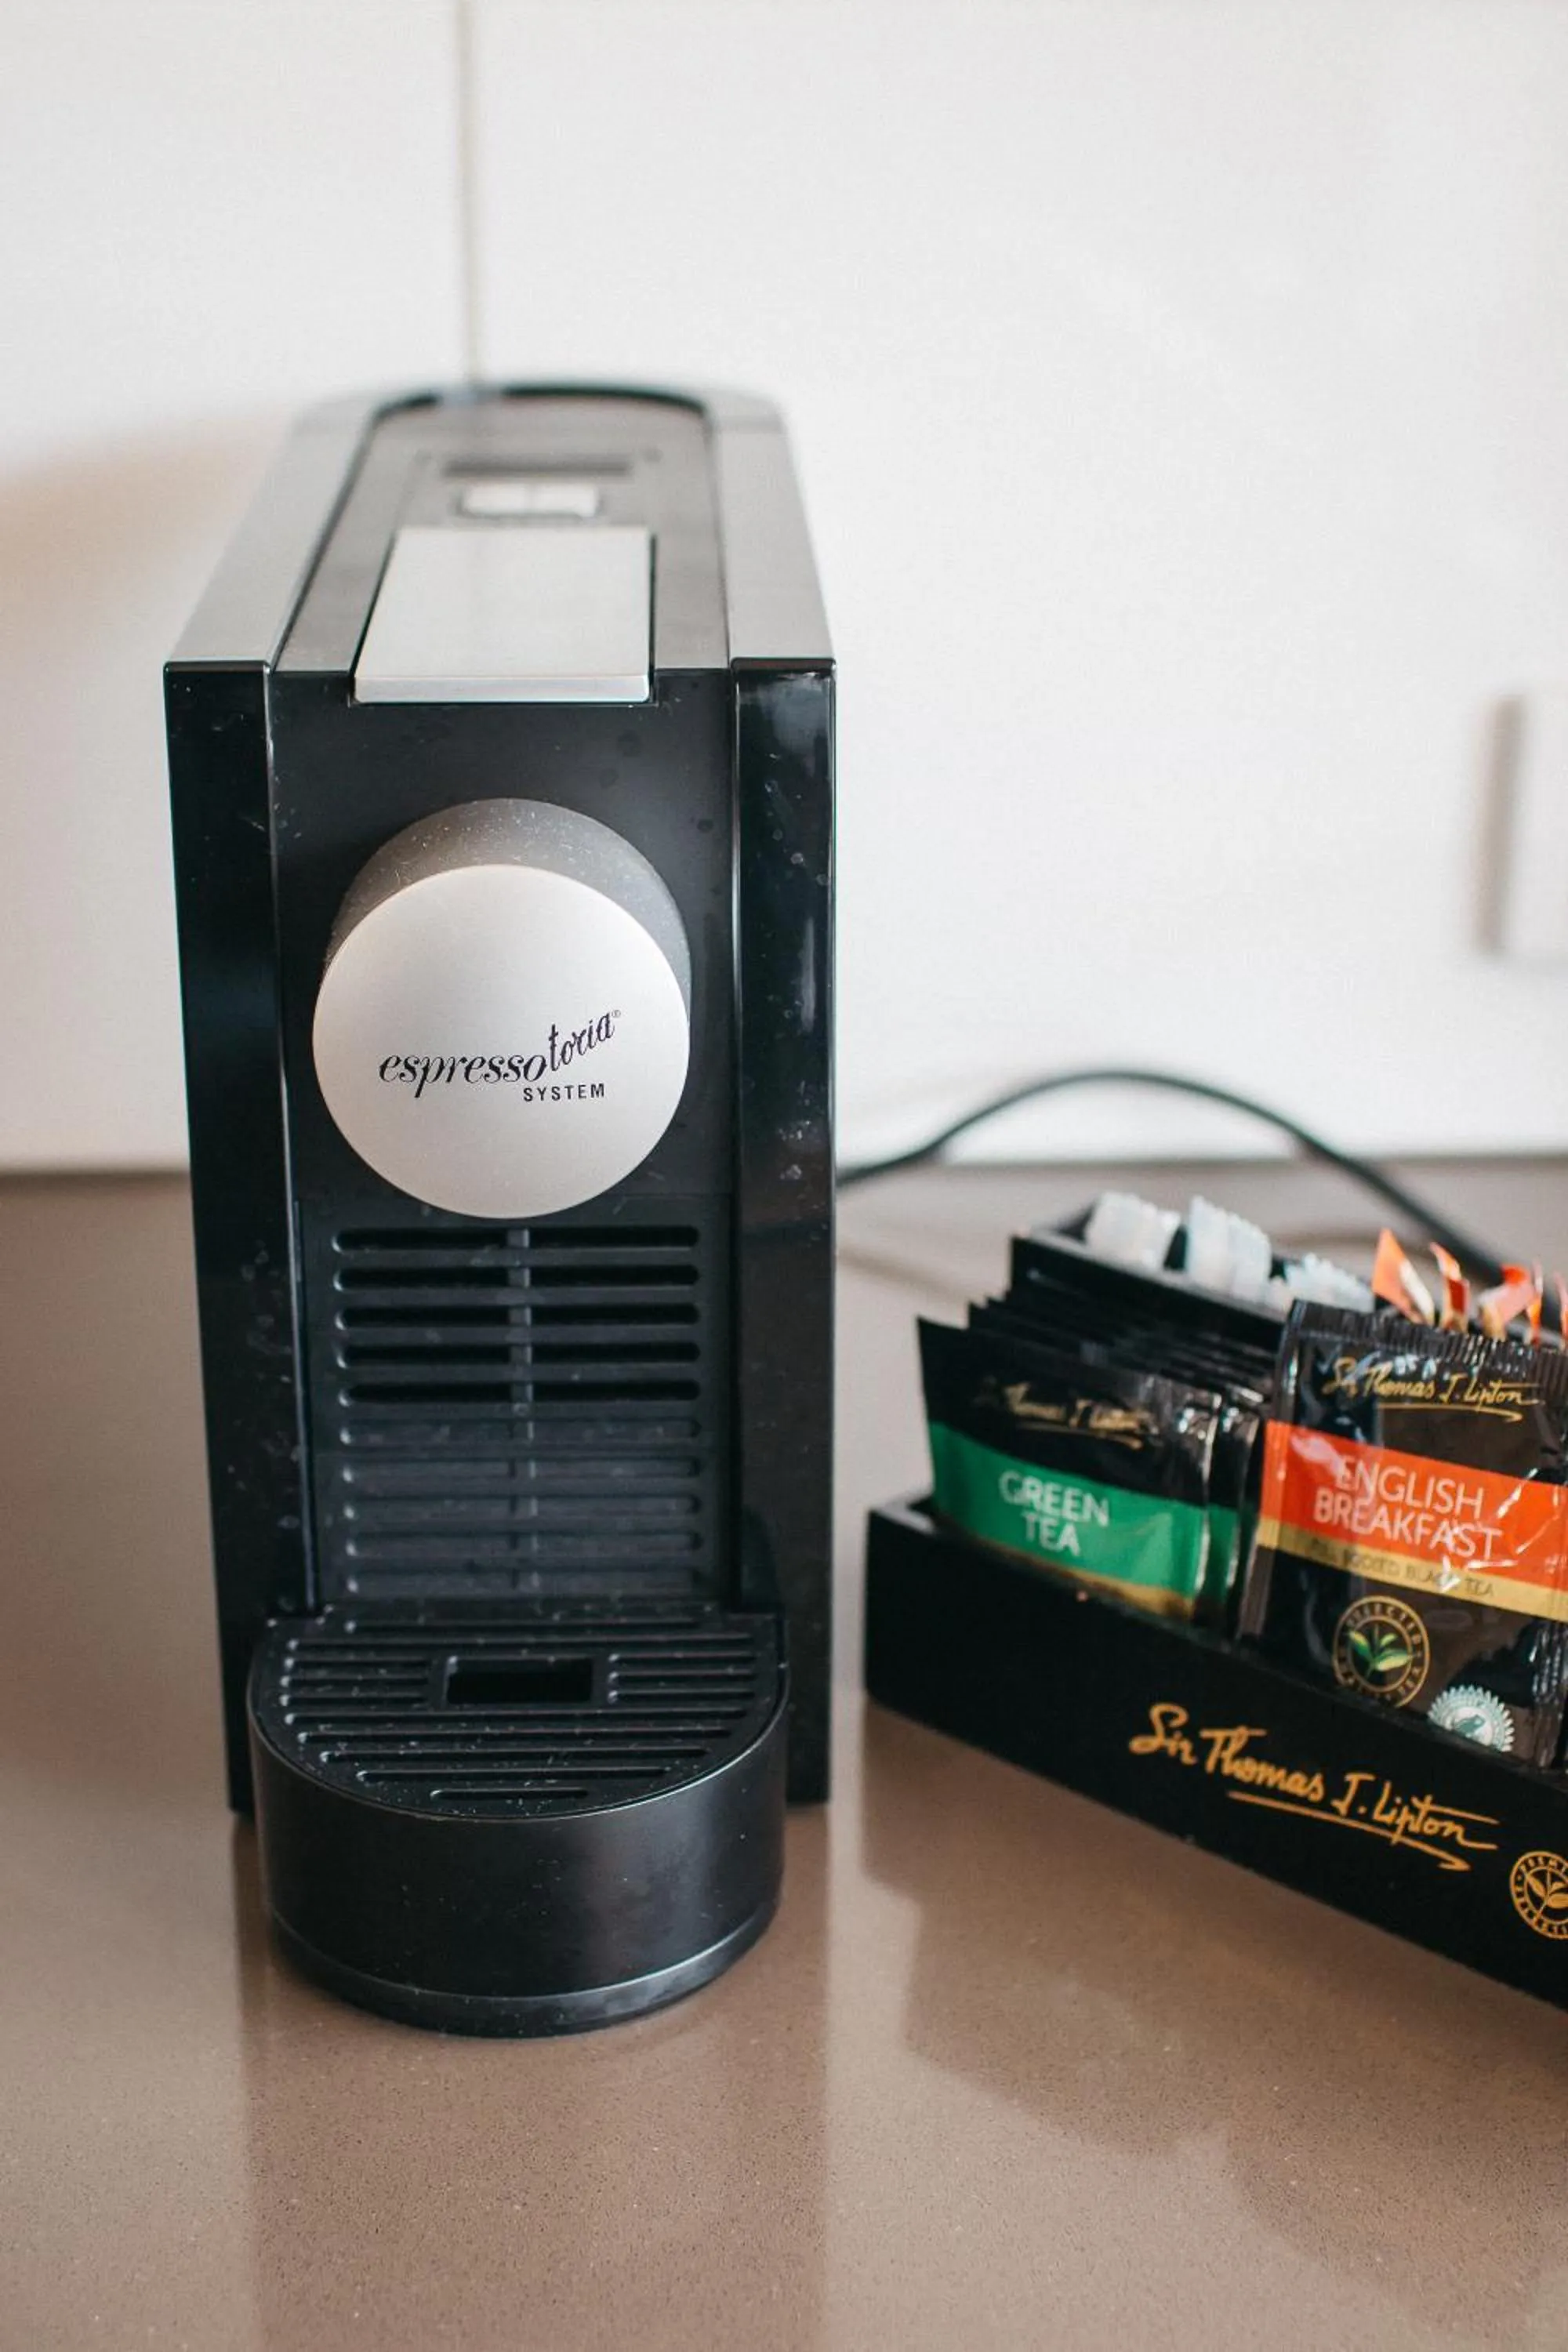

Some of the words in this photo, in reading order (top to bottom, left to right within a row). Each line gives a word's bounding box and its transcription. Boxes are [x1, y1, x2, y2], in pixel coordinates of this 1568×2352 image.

[523, 1083, 606, 1102] SYSTEM
[1464, 1377, 1545, 1413] Lipton
[998, 1470, 1110, 1527] GREEN
[1336, 1454, 1484, 1519] ENGLISH
[1020, 1511, 1080, 1557] TEA
[1313, 1488, 1503, 1560] BREAKFAST
[1129, 1703, 1198, 1765] Sir
[1200, 1726, 1326, 1803] Thomas
[1374, 1780, 1500, 1850] Lipton
